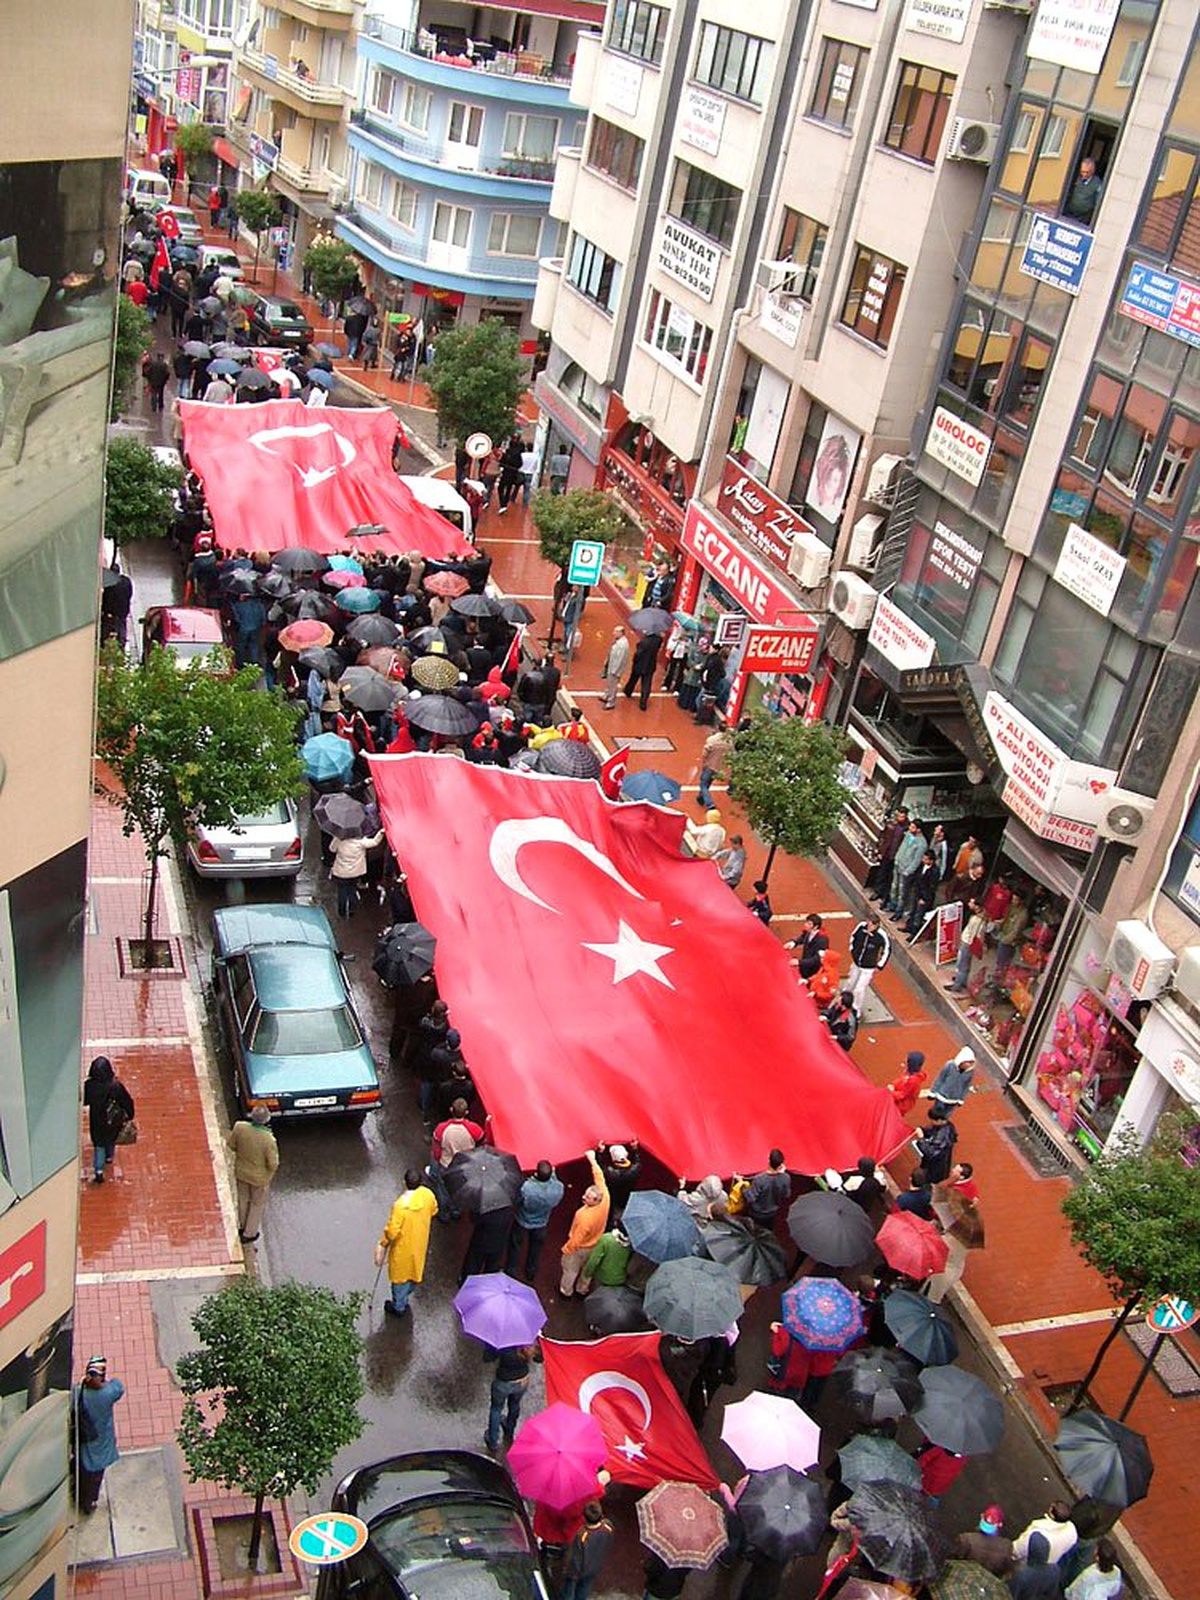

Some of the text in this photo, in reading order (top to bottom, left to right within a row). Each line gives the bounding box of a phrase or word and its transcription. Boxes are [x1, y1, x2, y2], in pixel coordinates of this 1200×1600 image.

[664, 224, 716, 262] AVUKAT
[694, 520, 771, 616] ECZANE
[725, 621, 741, 639] E
[747, 634, 815, 660] ECZANE
[1047, 814, 1096, 839] BERBER
